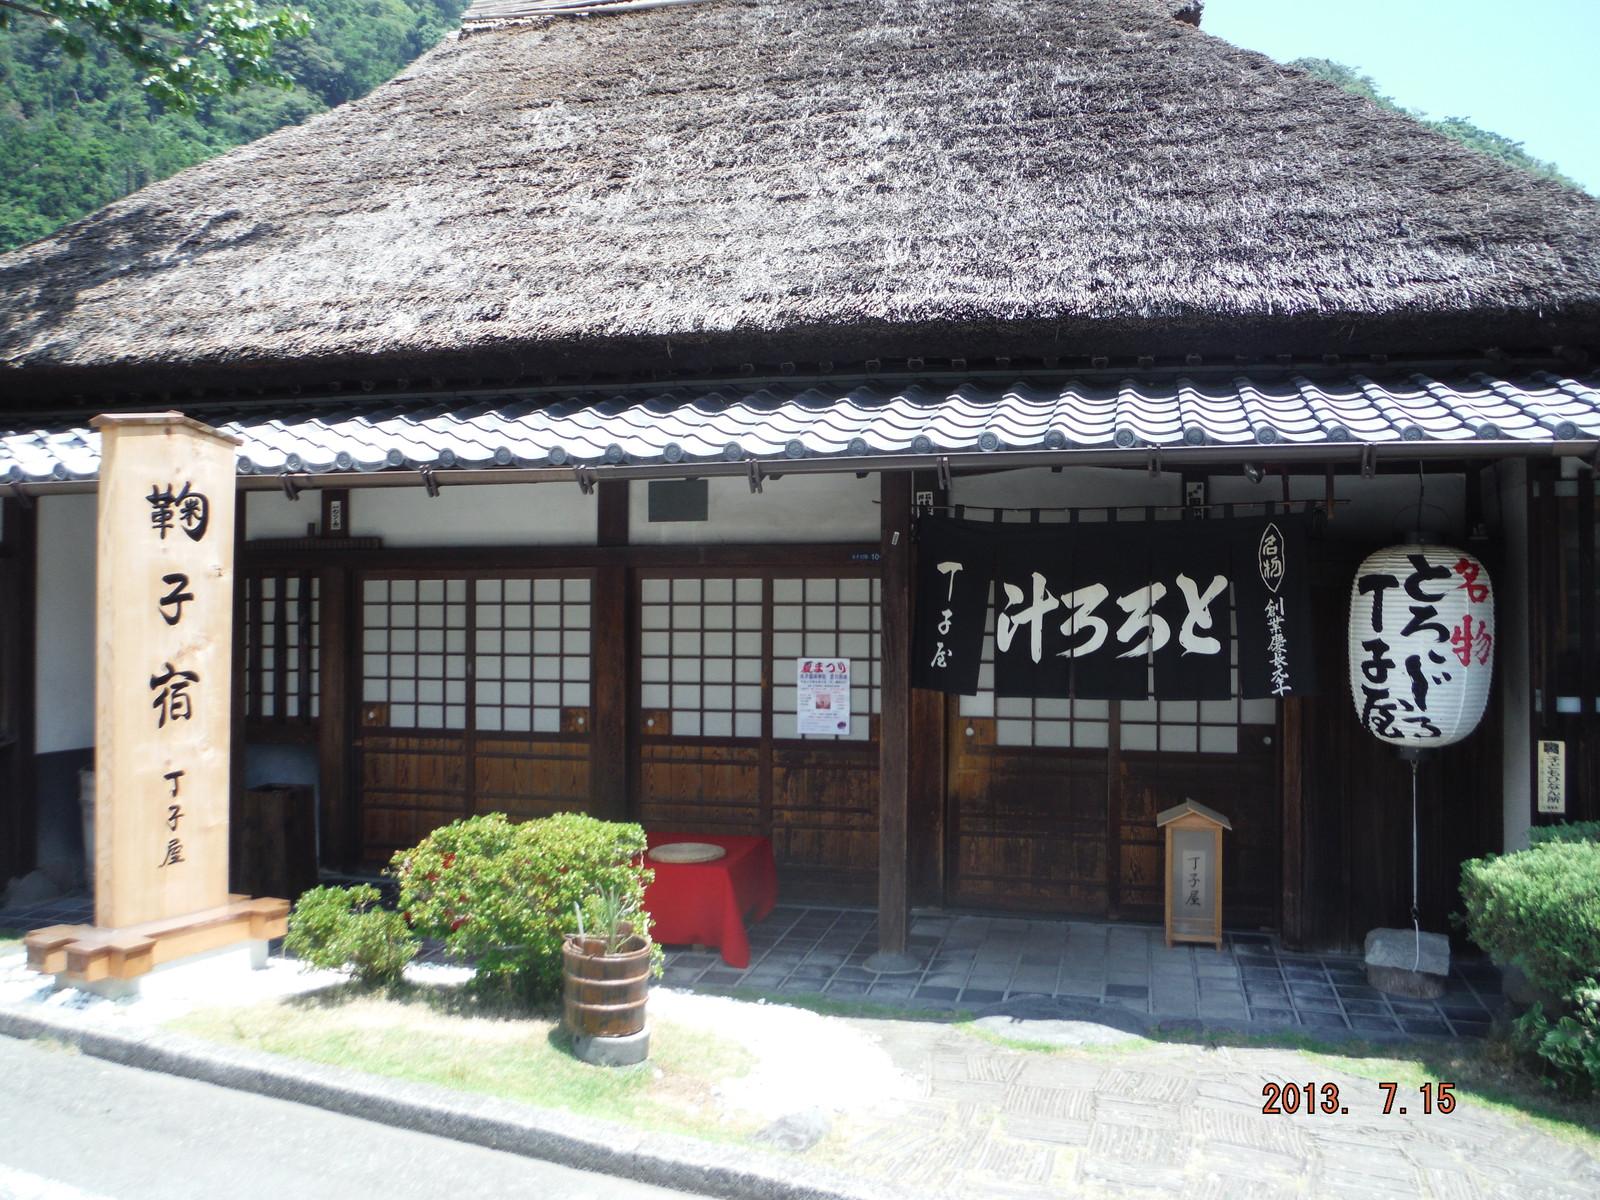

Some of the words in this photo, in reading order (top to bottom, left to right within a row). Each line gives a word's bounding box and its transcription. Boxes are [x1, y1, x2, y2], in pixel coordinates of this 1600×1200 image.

[146, 481, 210, 730] 鞠子宿
[1262, 534, 1283, 579] 名物
[930, 560, 964, 669] 丁子屋
[996, 571, 1230, 664] とろろ汁
[1264, 596, 1293, 698] 創業慶長元年
[1358, 574, 1406, 739] 丁子屋
[1450, 557, 1494, 668] 名物
[801, 660, 848, 674] 夏まつり
[158, 770, 186, 868] 丁子屋
[1185, 856, 1201, 906] 丁子屋
